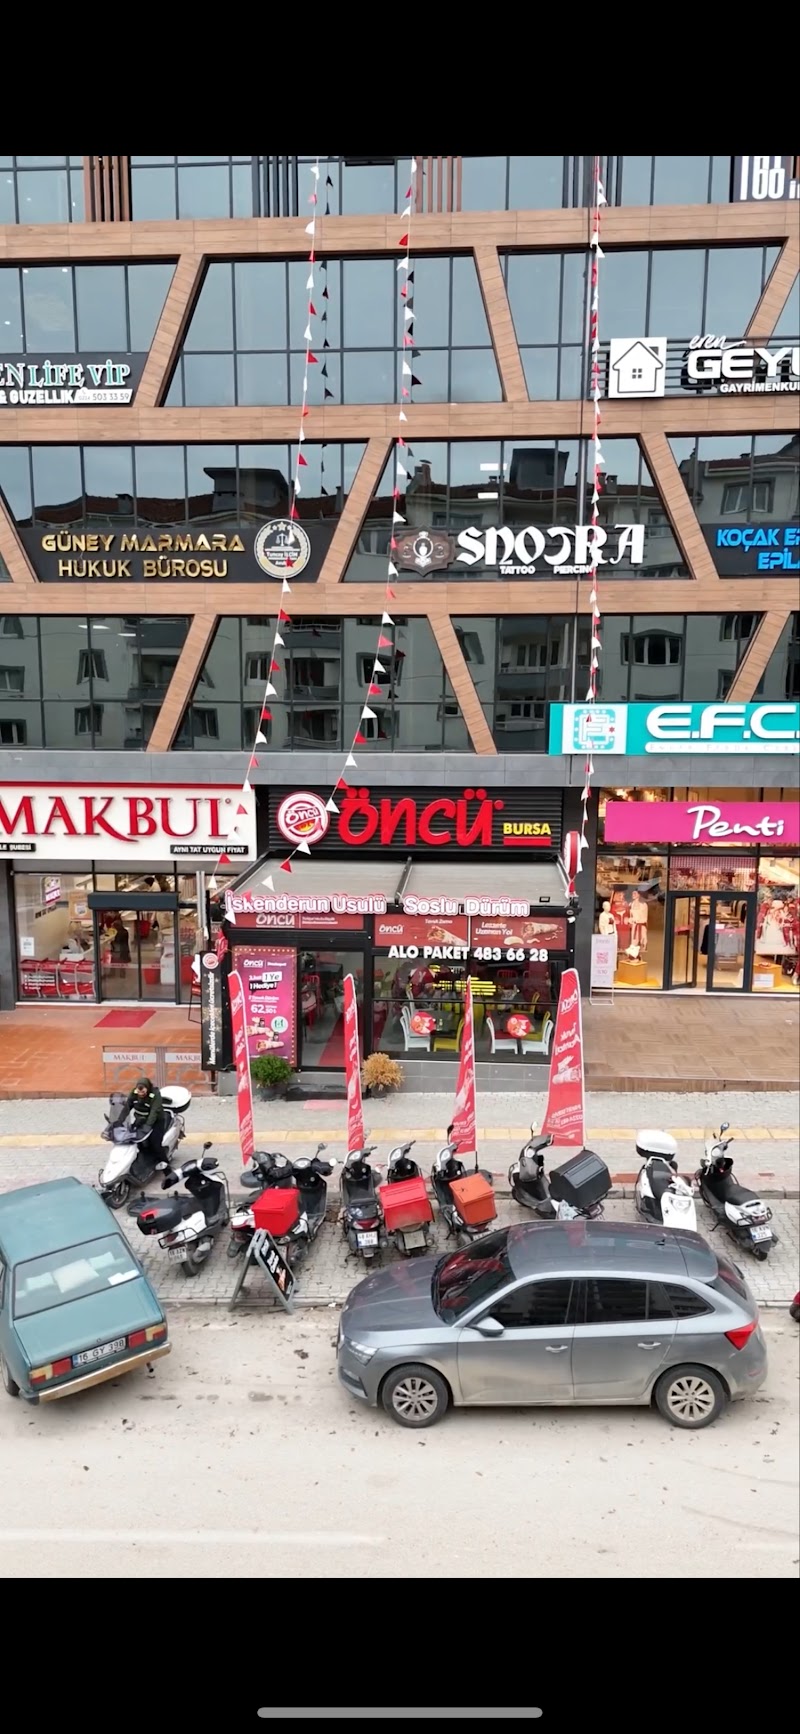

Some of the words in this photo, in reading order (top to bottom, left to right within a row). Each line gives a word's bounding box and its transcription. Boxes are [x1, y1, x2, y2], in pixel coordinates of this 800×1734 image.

[27, 360, 85, 388] LİFE
[87, 359, 131, 386] VİP
[688, 347, 799, 379] GEY
[109, 392, 119, 401] 33
[120, 392, 130, 401] 59
[720, 382, 799, 393] GAYRİMENKU
[41, 531, 115, 551] GÜNEY
[120, 534, 246, 552] MARMARA
[717, 529, 780, 552] KOÇAK
[58, 560, 131, 577] HUKUK
[143, 555, 229, 578] BÜROSU
[758, 548, 799, 569] EPİL
[500, 565, 536, 575] TATTOO
[0, 795, 228, 843] MAKBUL
[503, 823, 551, 836] BURSA
[687, 805, 784, 840] Penti
[404, 896, 458, 914] Soslu
[465, 896, 529, 915] Dürüm
[388, 945, 419, 959] ALO
[423, 946, 469, 960] PAKET
[474, 947, 501, 961] 483
[506, 948, 525, 962] 66
[529, 949, 549, 962] 28
[79, 1353, 89, 1362] 16
[92, 1346, 105, 1357] GY
[108, 1339, 125, 1351] 398
